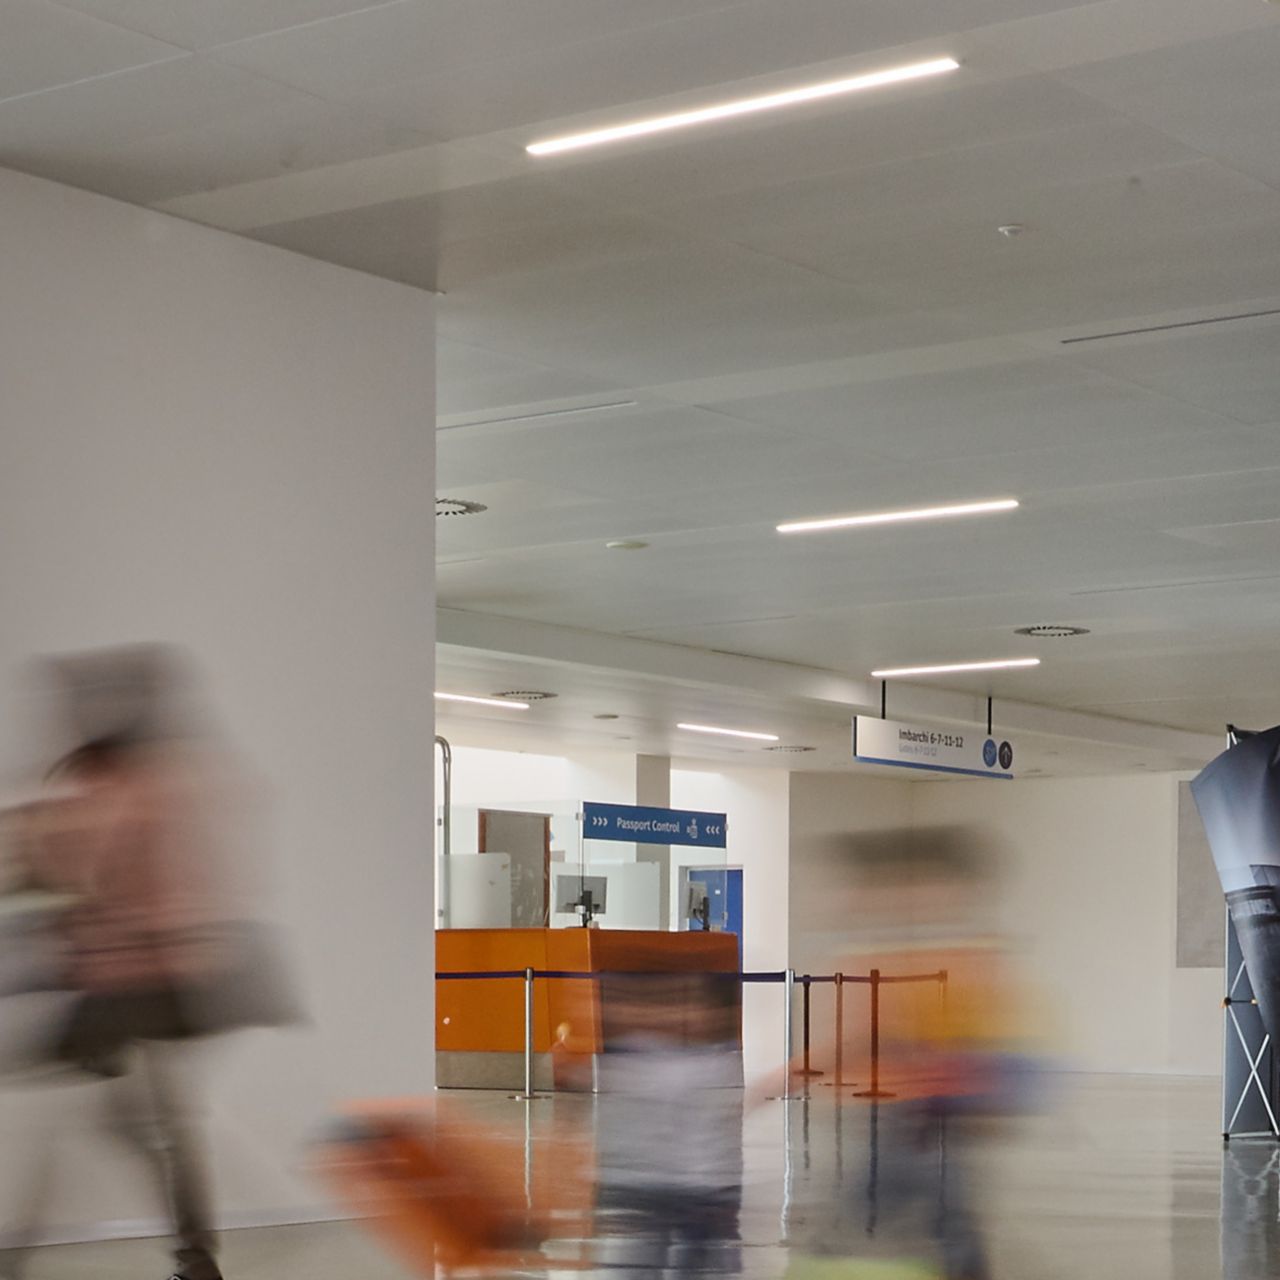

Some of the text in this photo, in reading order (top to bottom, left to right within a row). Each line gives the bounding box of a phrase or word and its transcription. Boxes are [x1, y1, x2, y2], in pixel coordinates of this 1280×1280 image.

[899, 729, 963, 748] Imbarchi 6-7-11-12
[616, 817, 680, 832] Passport Control
